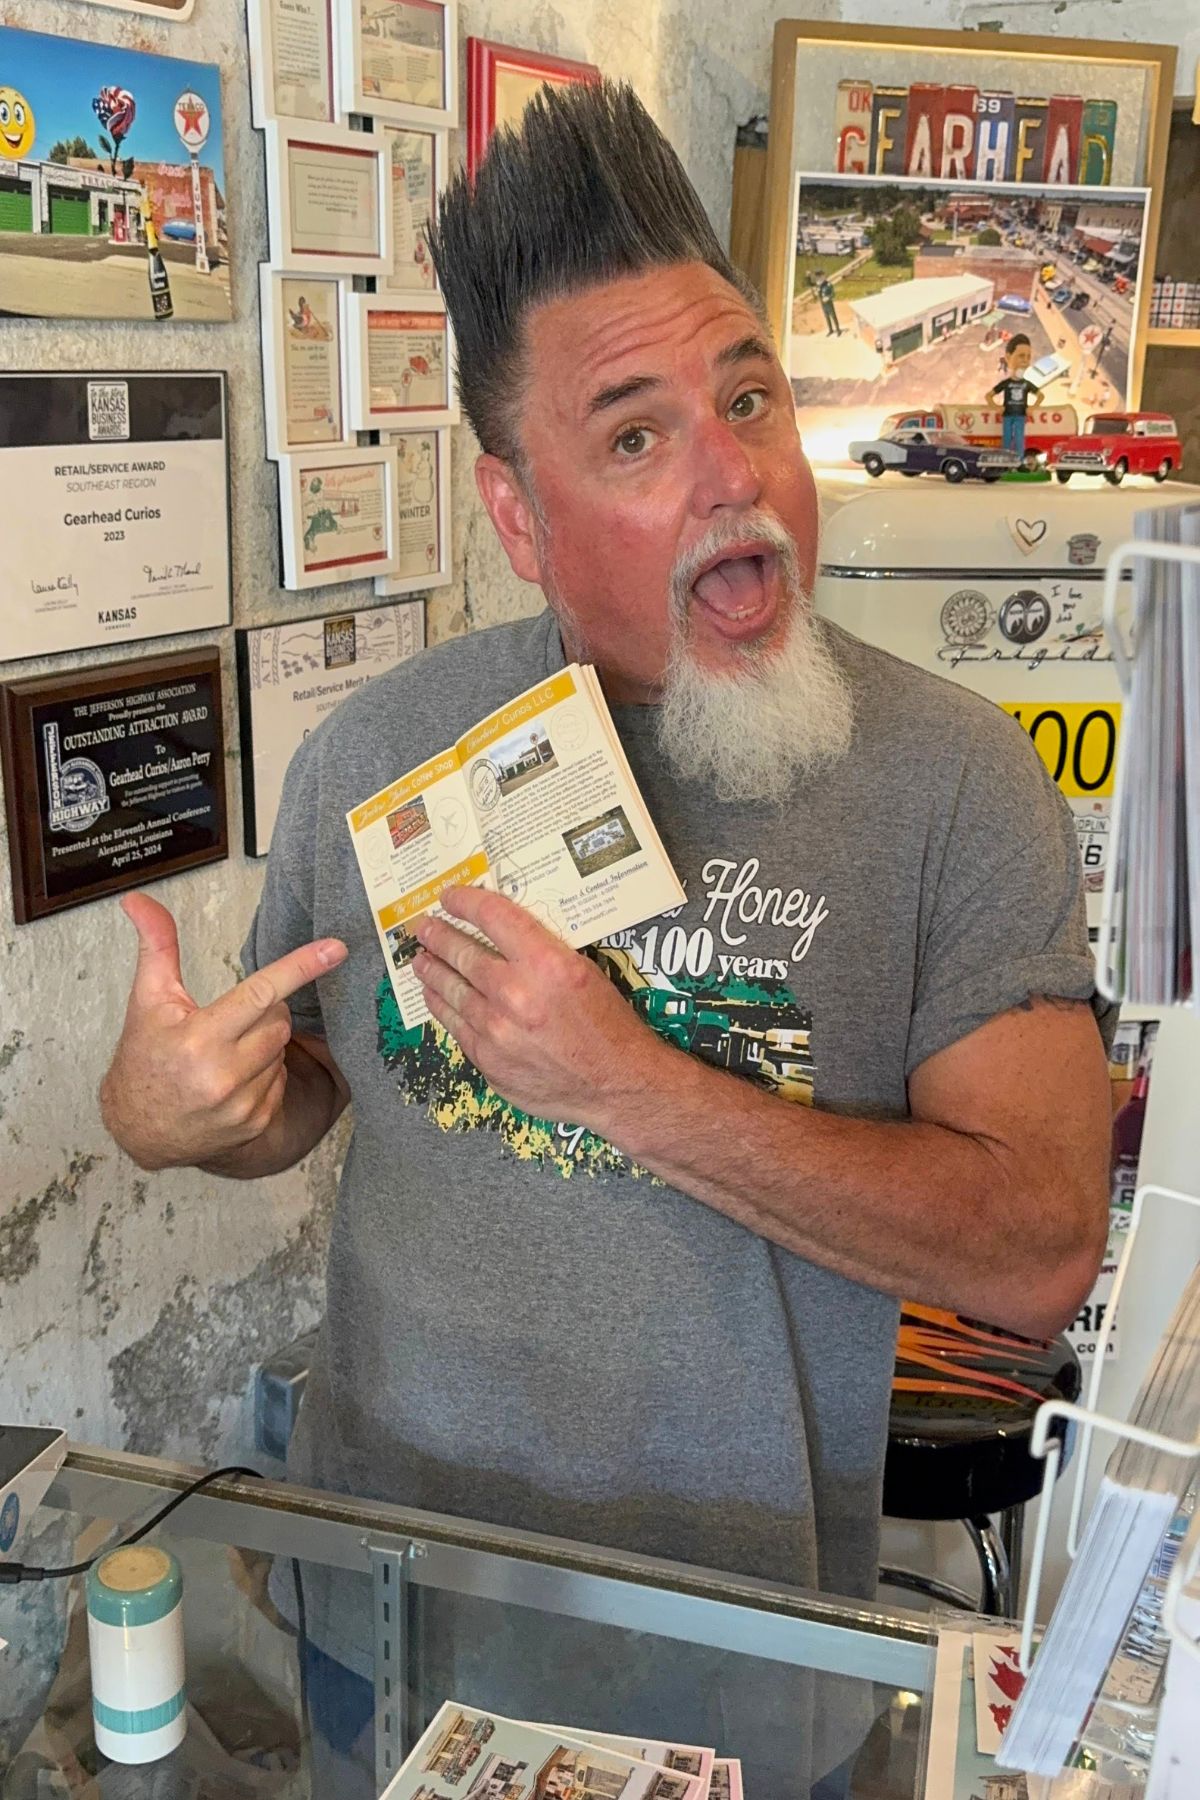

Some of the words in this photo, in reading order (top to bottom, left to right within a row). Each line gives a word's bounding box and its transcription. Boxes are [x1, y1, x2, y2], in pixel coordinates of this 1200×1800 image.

[848, 88, 873, 112] OK
[91, 397, 126, 412] KANSAS
[91, 412, 127, 425] BUSINESS
[980, 412, 1063, 425] TEACO
[54, 462, 129, 476] RETAIL/SERVICE
[131, 460, 166, 472] AWARD
[66, 480, 120, 493] SOUTHEAST
[122, 478, 157, 489] REGION
[63, 508, 122, 526] Gearhead
[124, 506, 161, 521] Curios
[400, 505, 431, 519] WINTER
[103, 530, 125, 542] 2023
[98, 607, 137, 624] KANSAS
[73, 705, 88, 717] THE
[88, 698, 124, 717] JEFFERSON
[125, 692, 156, 707] HIGHWAY
[157, 683, 197, 700] ASSOCIATION
[156, 703, 166, 711] the
[502, 701, 532, 726] Curios
[532, 687, 554, 707] LLC
[63, 724, 126, 751] OUTSTANDING
[128, 712, 179, 736] ATTRACTION
[181, 706, 208, 724] AWARD
[154, 744, 166, 755] To
[109, 764, 144, 787] Gearhead
[192, 751, 211, 767] Perry
[52, 798, 107, 822] HIGHWAY
[51, 837, 91, 857] Presented
[100, 833, 112, 843] the
[113, 824, 146, 840] Eleventh
[146, 814, 172, 829] Annual
[172, 805, 211, 822] Conference
[97, 840, 139, 858] Alexandria,
[139, 829, 173, 845] Louisiana
[111, 853, 131, 867] April
[144, 844, 162, 857] 2024
[609, 861, 648, 882] Information
[701, 856, 830, 963] Honey
[638, 924, 714, 977] 100
[717, 953, 789, 983] years
